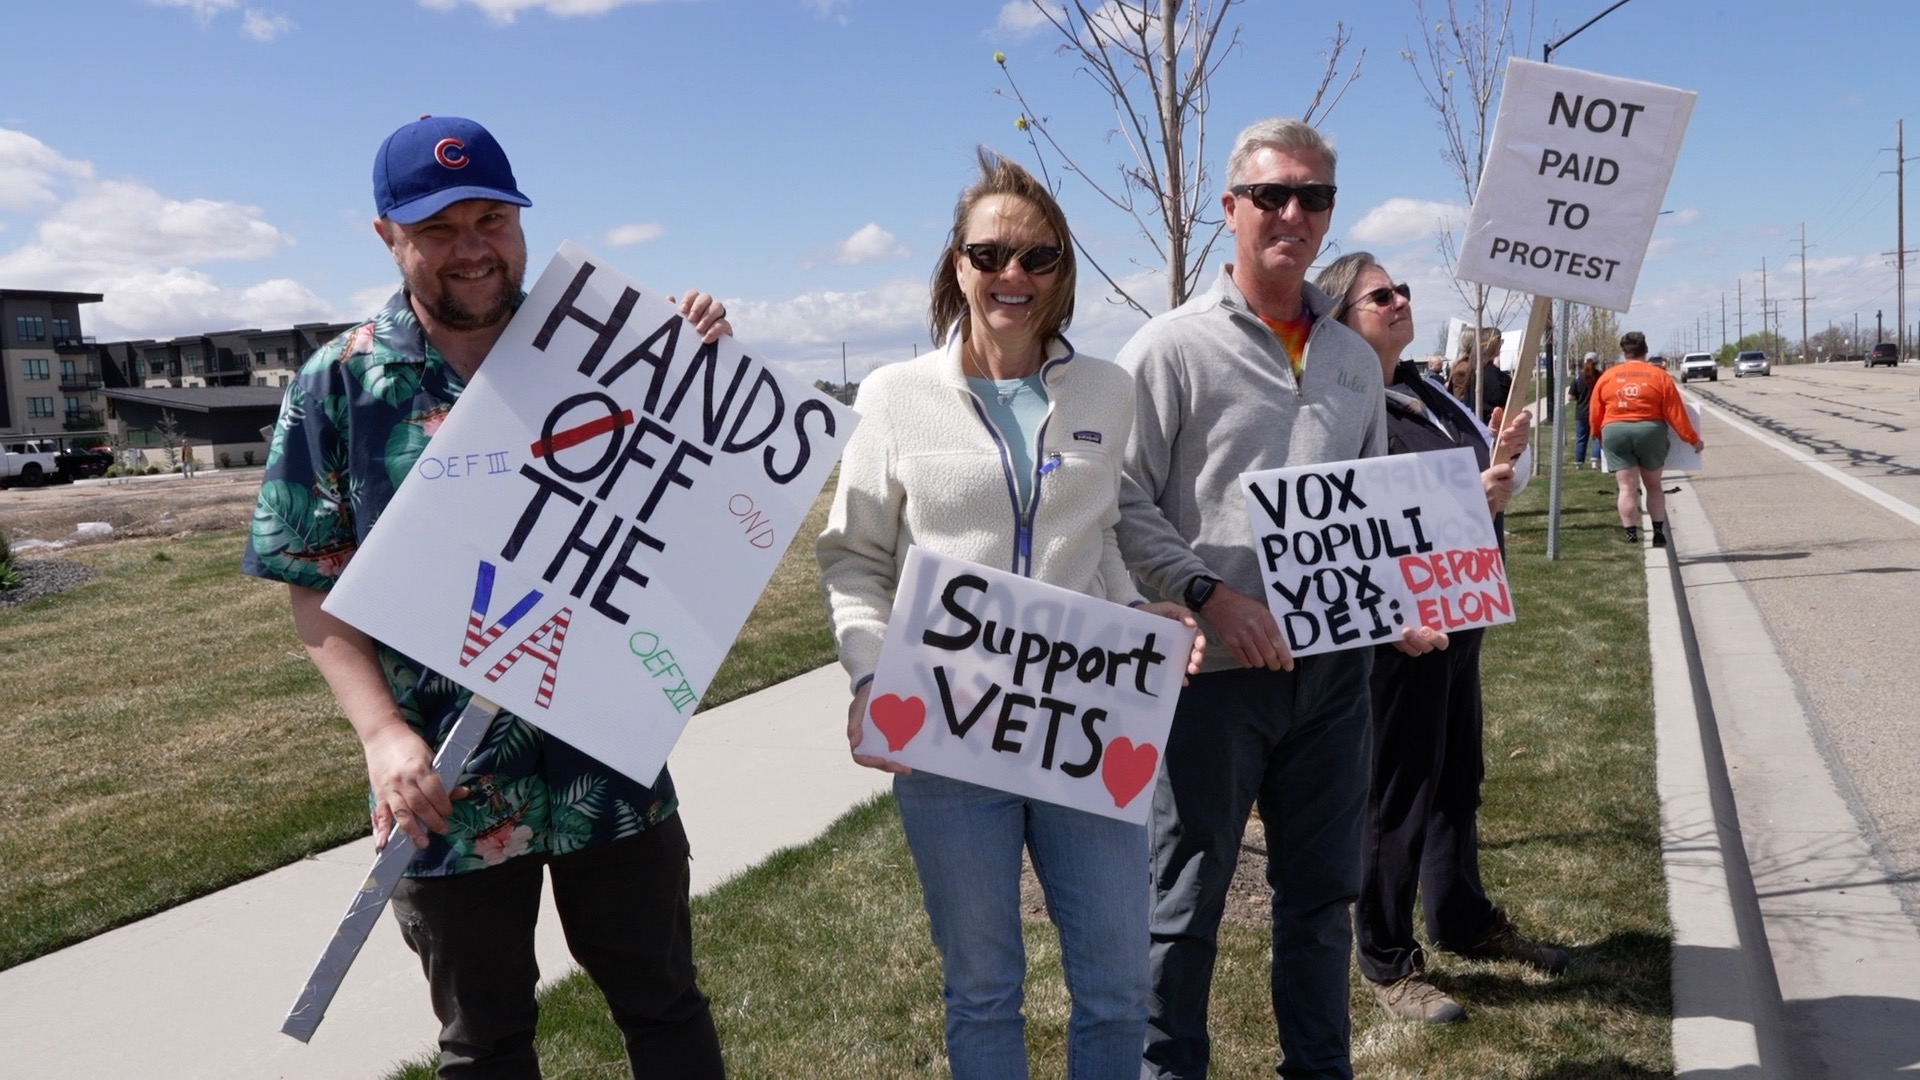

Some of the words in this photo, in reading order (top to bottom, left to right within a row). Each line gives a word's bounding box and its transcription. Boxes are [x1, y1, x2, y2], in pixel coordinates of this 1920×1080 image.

[1548, 91, 1645, 138] NOT
[434, 137, 470, 170] C
[1538, 148, 1620, 186] PAID
[1547, 198, 1590, 230] TO
[1489, 237, 1621, 282] PROTEST
[532, 261, 836, 485] HANDS
[419, 454, 479, 480] OEF
[485, 451, 512, 475] III
[538, 391, 713, 524] OFF
[729, 494, 774, 549] OND
[1249, 468, 1367, 530] VOX
[500, 463, 666, 625] THE
[1261, 506, 1433, 573] POPULI
[1271, 564, 1386, 611] VOX
[1399, 547, 1502, 595] DEPORT
[1416, 582, 1511, 632] ELON
[459, 560, 573, 710] VA
[922, 574, 1166, 697] Support
[629, 631, 684, 679] OEF
[662, 679, 698, 714] XII
[933, 665, 1108, 779] VETS
